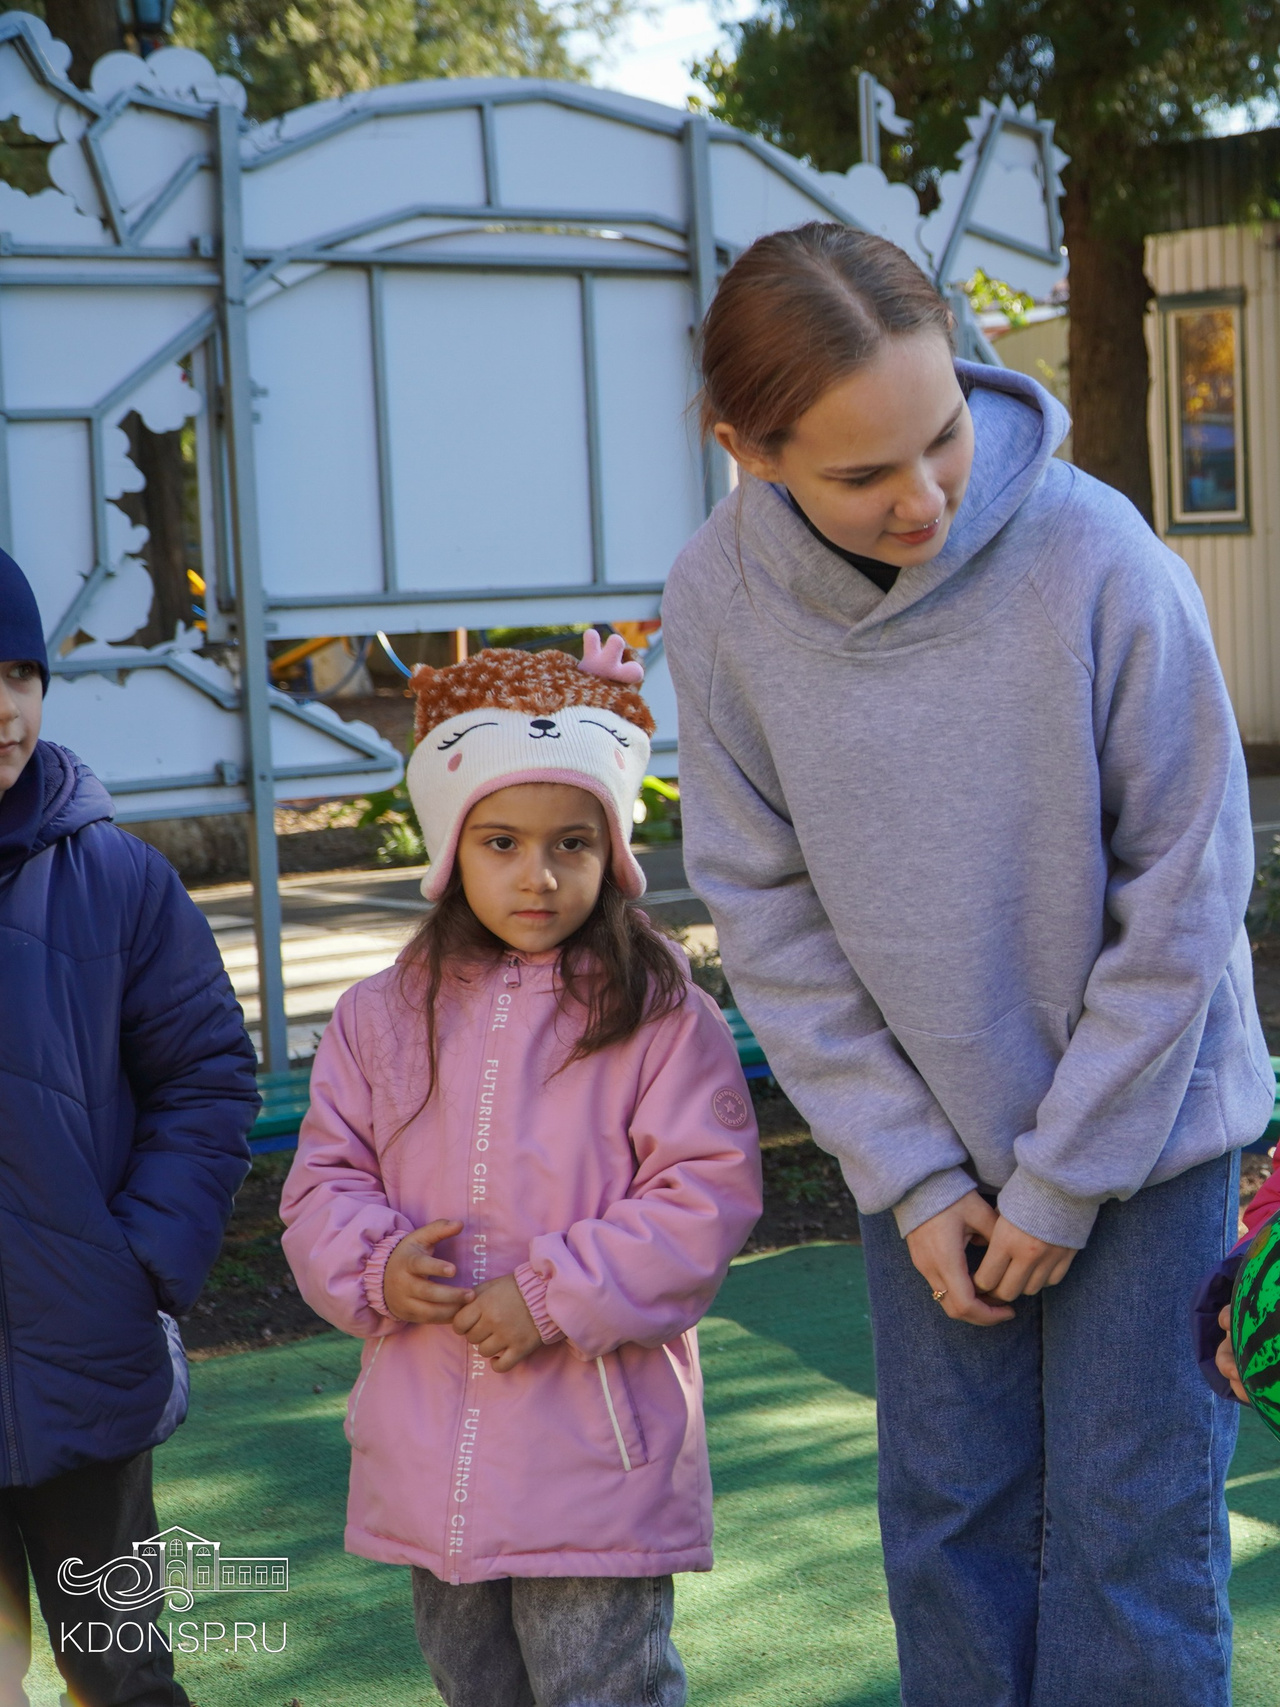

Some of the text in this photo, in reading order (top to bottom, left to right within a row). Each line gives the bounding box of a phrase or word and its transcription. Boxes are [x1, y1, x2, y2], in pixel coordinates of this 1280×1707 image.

[492, 993, 512, 1032] GIRL
[473, 1059, 499, 1205] FUTURINO GIRL
[472, 1234, 487, 1286] FUTU
[449, 1408, 480, 1557] FUTURINO GIRL
